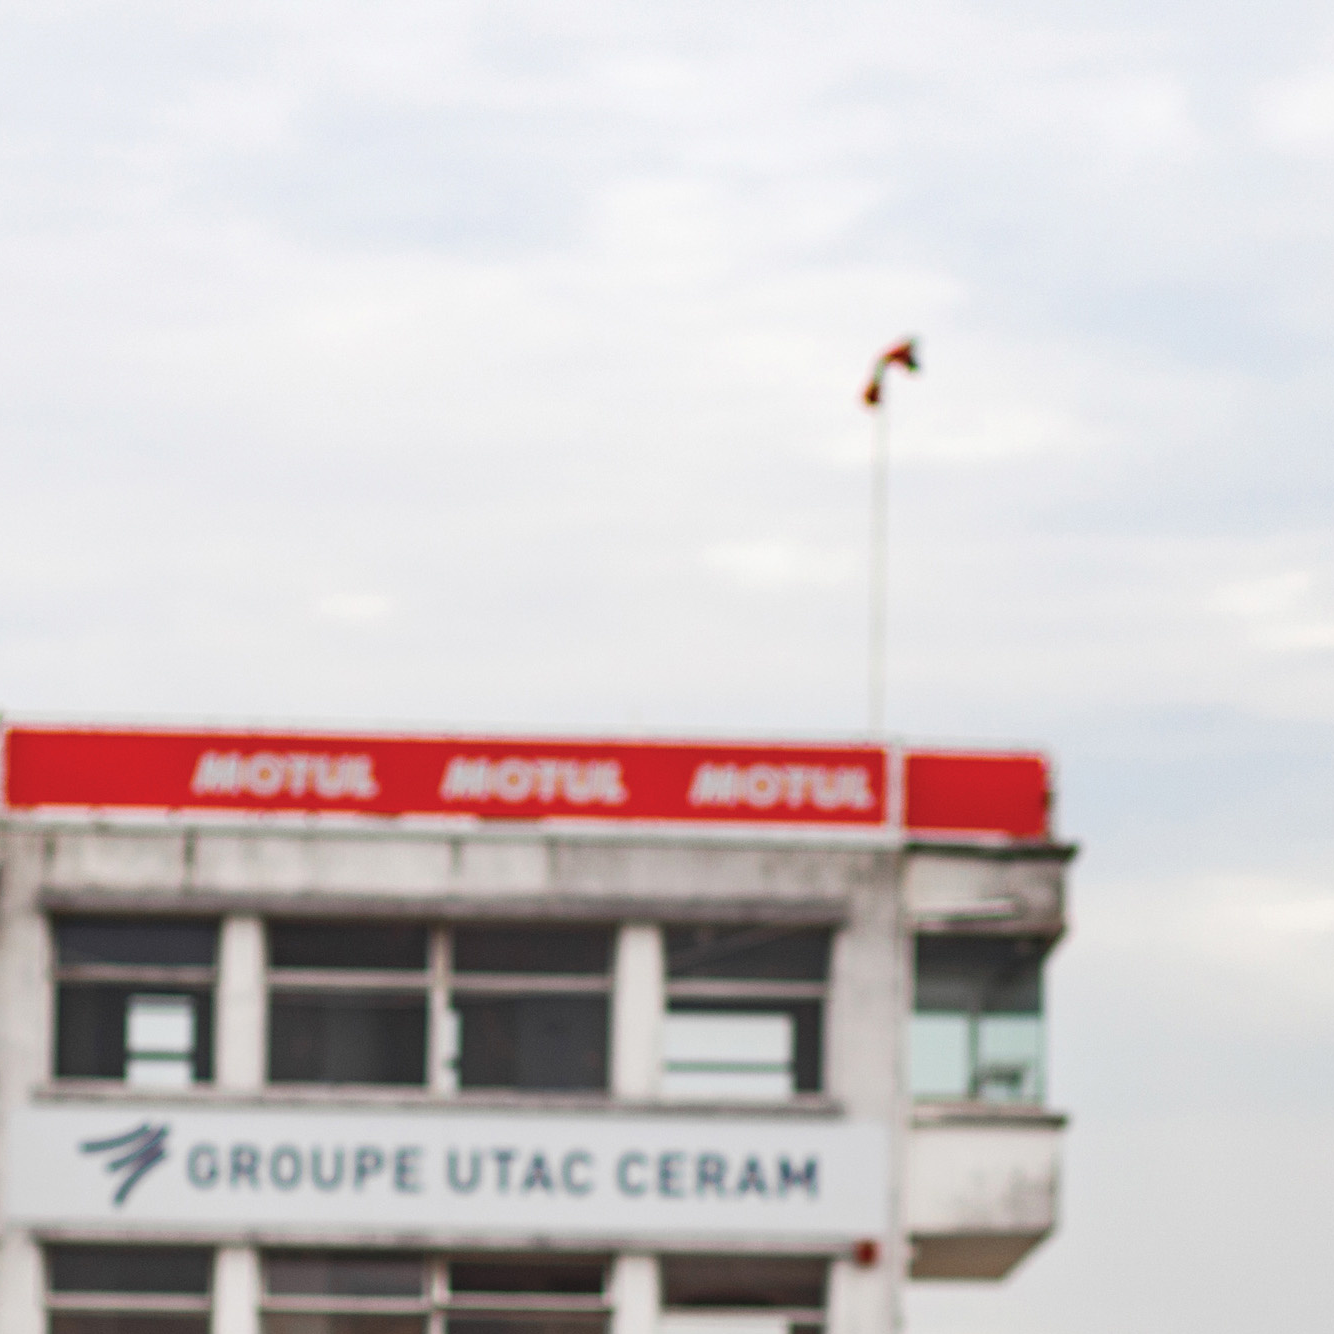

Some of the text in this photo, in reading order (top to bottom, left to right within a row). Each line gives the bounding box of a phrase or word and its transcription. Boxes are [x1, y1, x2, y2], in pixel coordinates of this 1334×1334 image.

[190, 752, 875, 809] MOTUL MOTUL MOTUL
[186, 1143, 821, 1199] GROUPE UTAC CERAM
